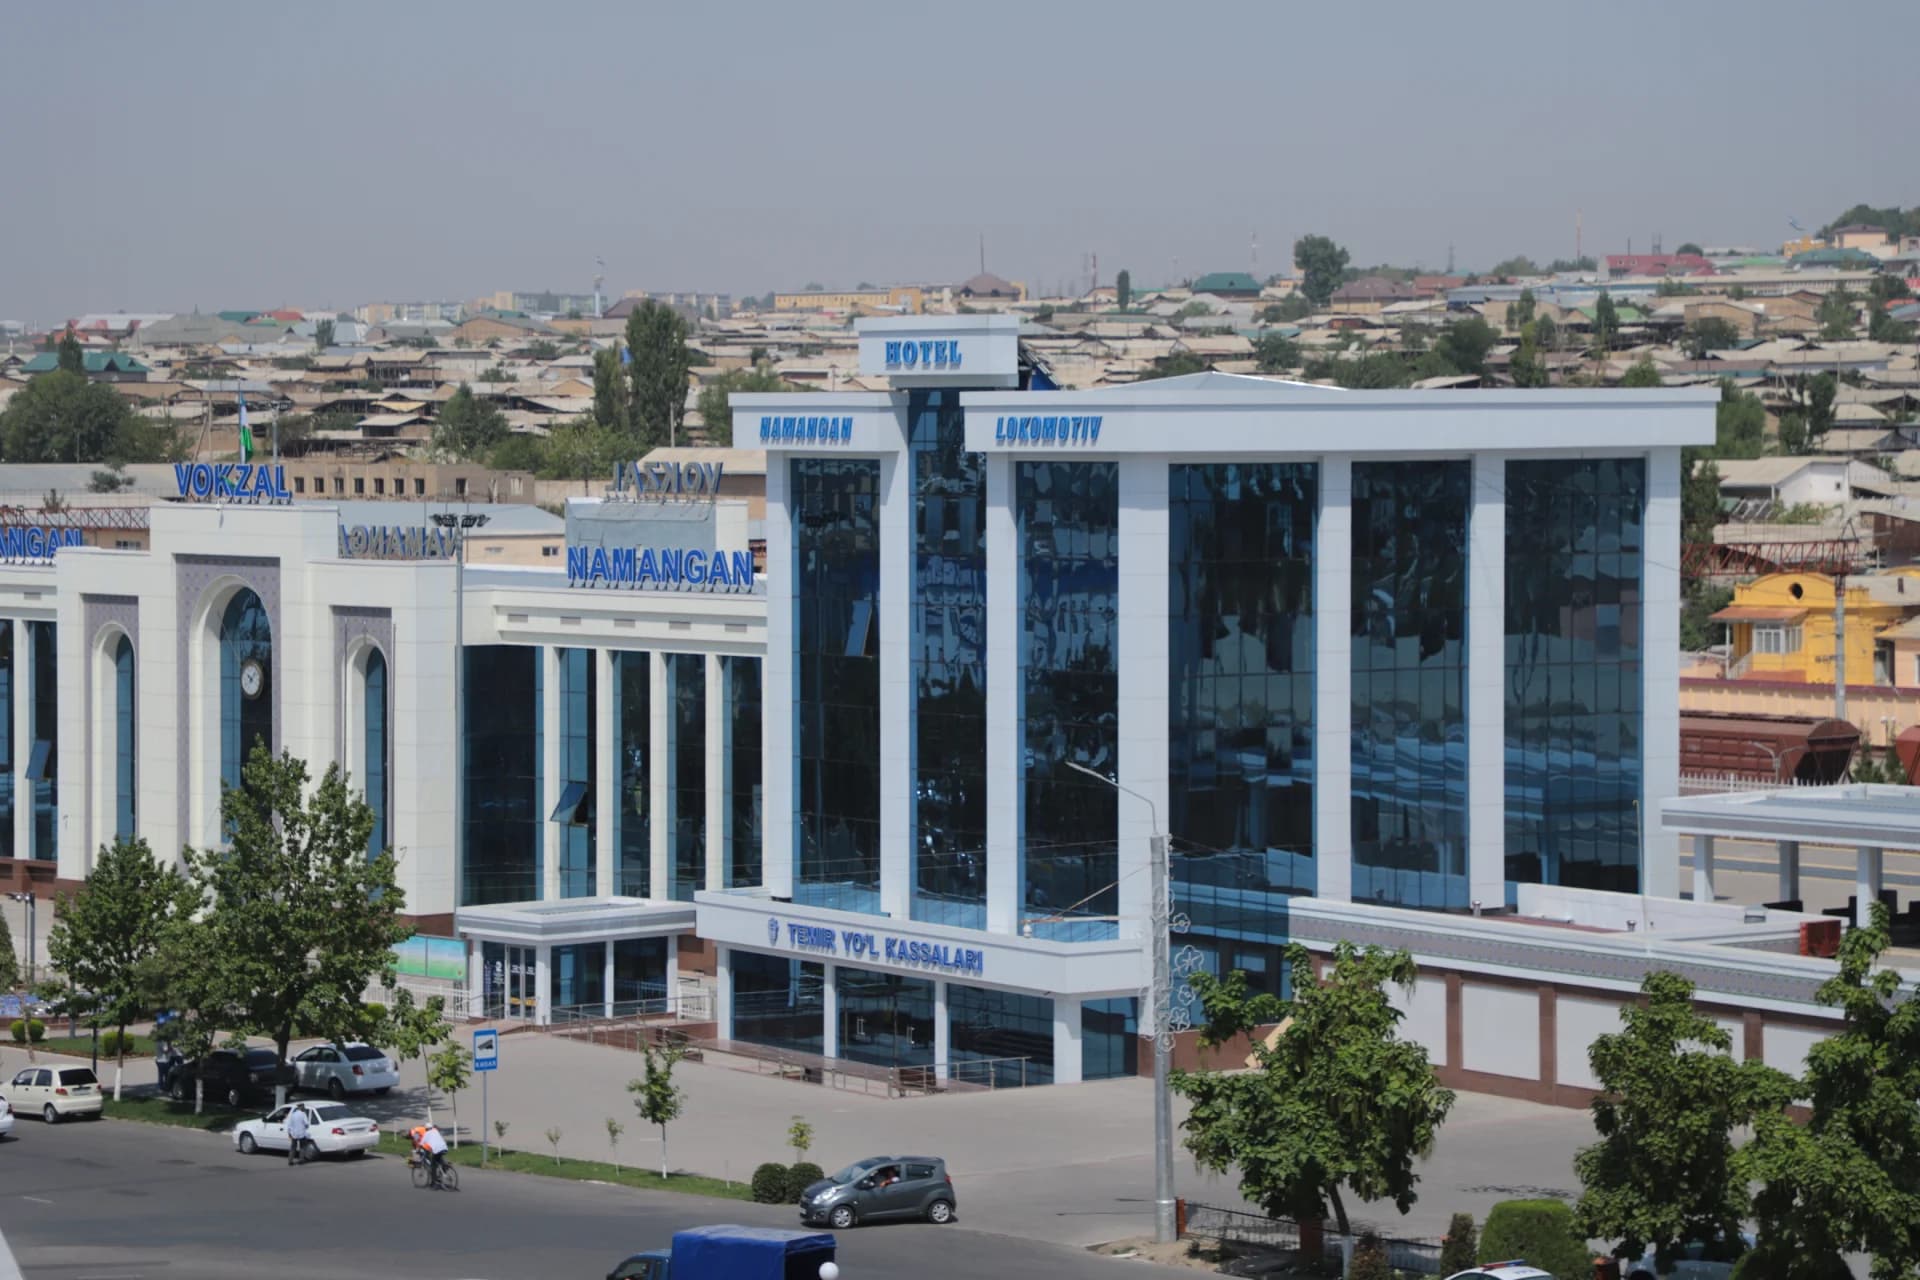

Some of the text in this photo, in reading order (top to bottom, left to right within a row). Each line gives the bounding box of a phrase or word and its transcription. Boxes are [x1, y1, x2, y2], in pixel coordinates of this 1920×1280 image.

[885, 340, 962, 365] HOTEL
[760, 416, 853, 440] NAMANGAN
[995, 416, 1103, 441] LOKOMOTIV
[175, 463, 290, 498] VOKZAL
[567, 546, 754, 585] NAMANGAN
[787, 923, 836, 950] TEMIR
[884, 937, 984, 973] KASSALARI
